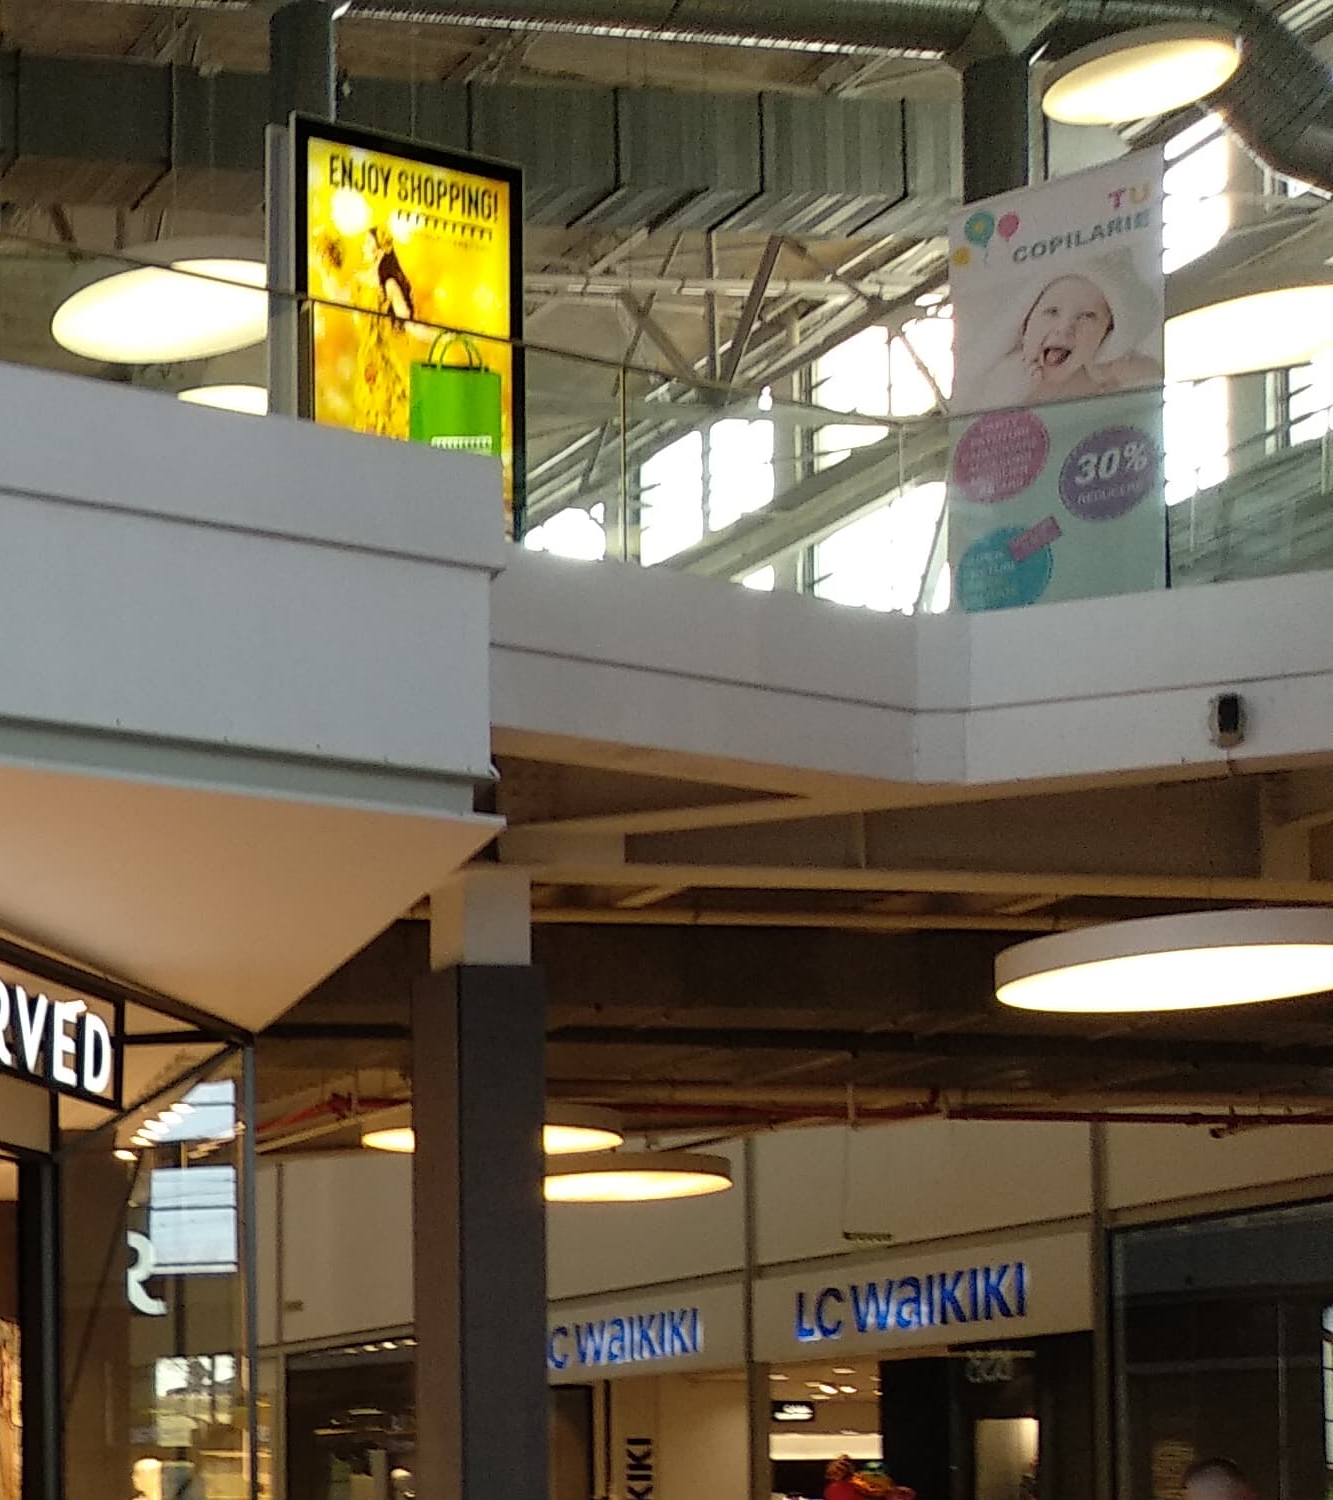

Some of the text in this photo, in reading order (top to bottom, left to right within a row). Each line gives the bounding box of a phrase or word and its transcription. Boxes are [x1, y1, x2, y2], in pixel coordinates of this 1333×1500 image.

[329, 154, 499, 224] ENJOY SHOPPING!
[1109, 181, 1152, 210] TU
[1012, 208, 1150, 263] COPILARIE
[1074, 441, 1150, 486] 30%
[796, 1287, 846, 1342] LC
